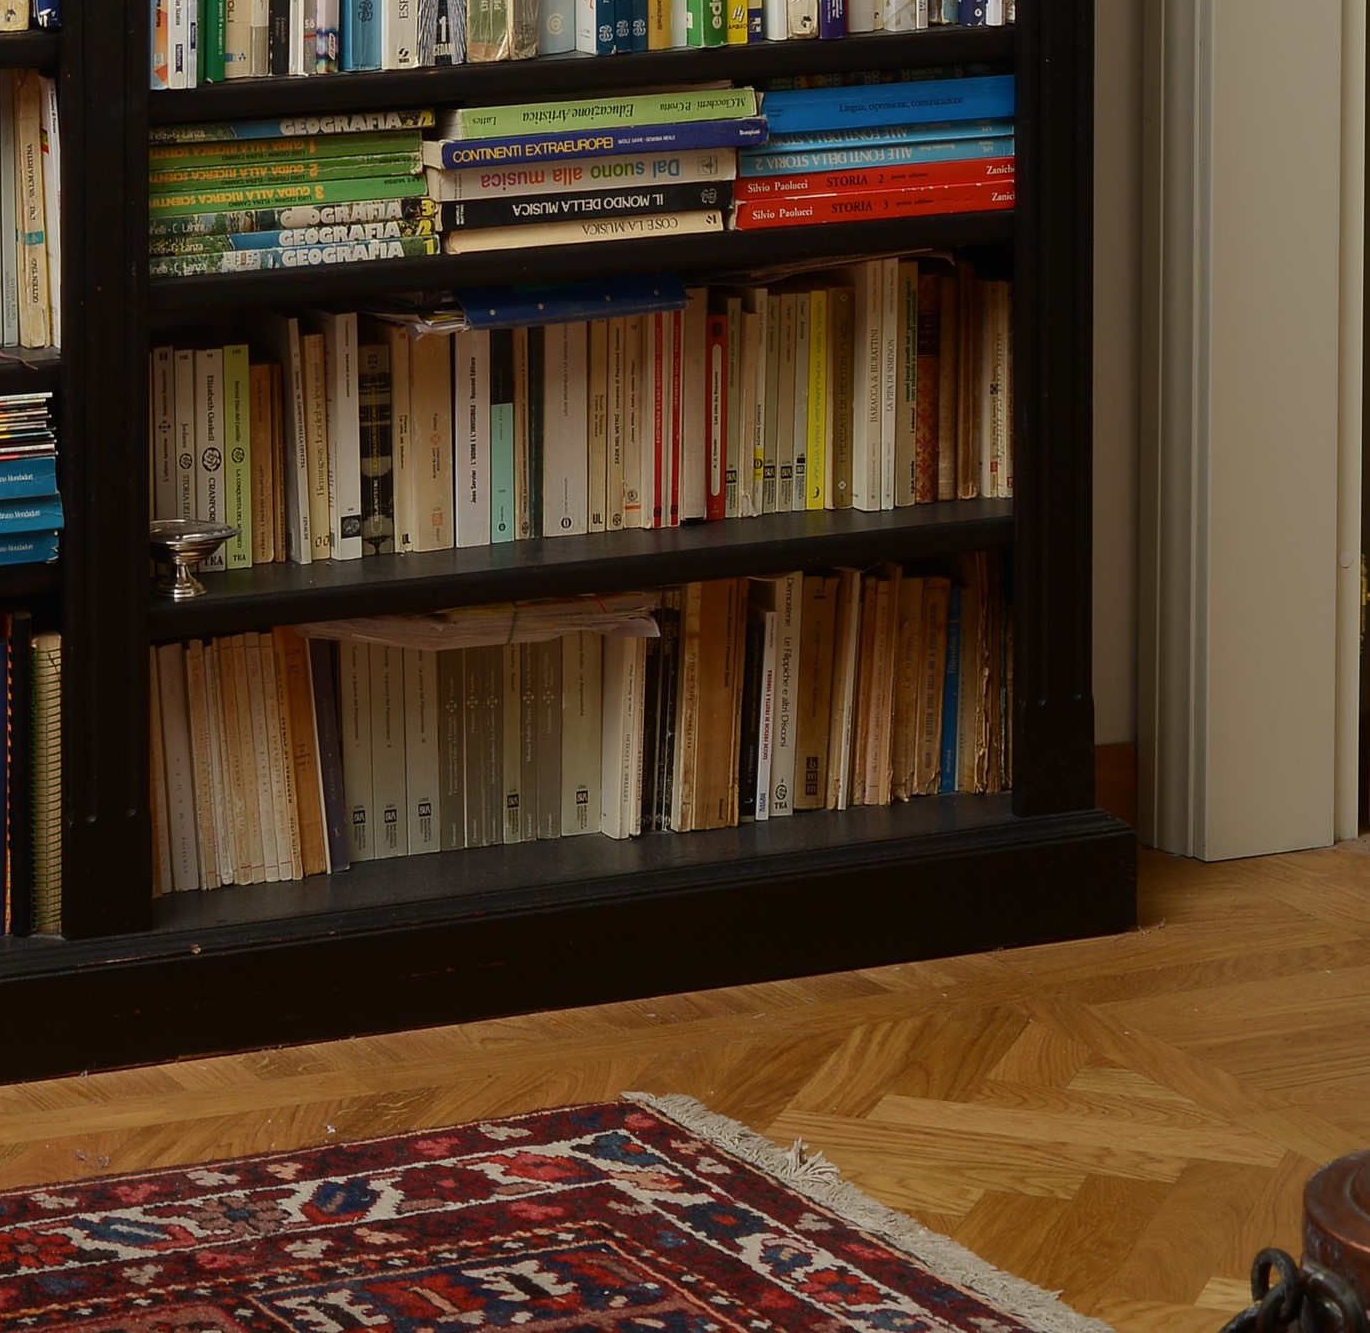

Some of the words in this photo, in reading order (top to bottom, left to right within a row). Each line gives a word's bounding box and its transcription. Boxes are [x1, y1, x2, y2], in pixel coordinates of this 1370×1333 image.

[280, 112, 402, 135] GEOGRAFIA
[419, 111, 433, 127] 2
[452, 145, 522, 163] CONTINENTI
[526, 137, 613, 156] EXTRAEUROPEI
[552, 167, 582, 181] alla
[591, 162, 644, 178] suono
[653, 159, 679, 176] Dal
[481, 170, 545, 190] musica
[561, 198, 601, 212] DELLA
[604, 196, 650, 208] MONDO
[653, 194, 663, 204] IL
[513, 202, 558, 216] MUSICA
[282, 241, 404, 267] GEOGRAFIA
[423, 240, 435, 255] 1
[233, 554, 246, 562] TEA
